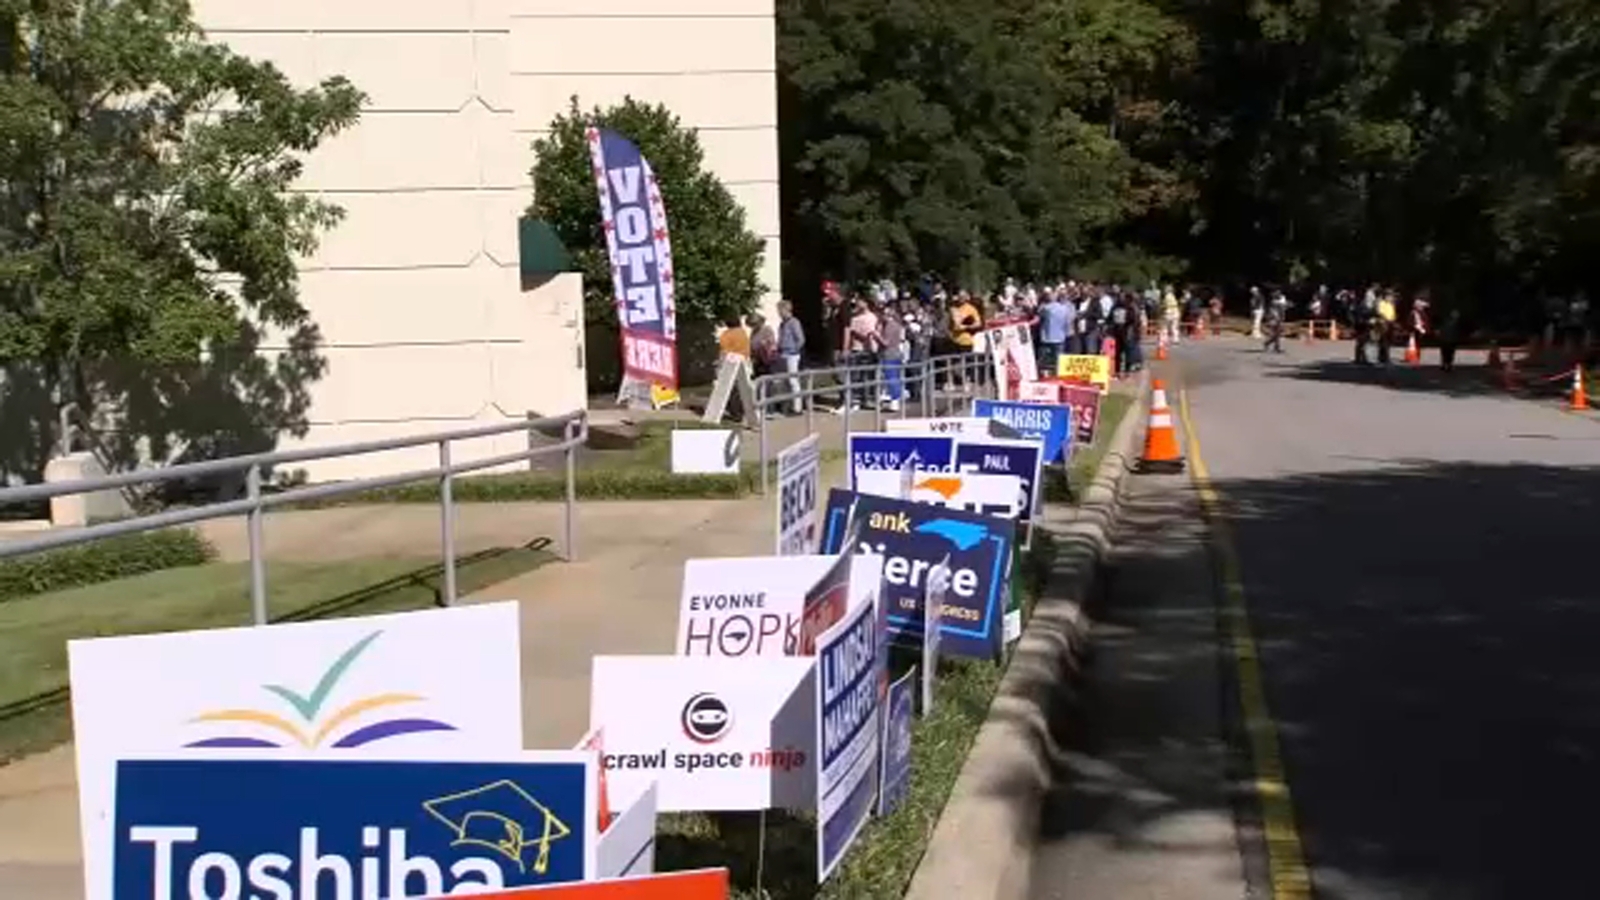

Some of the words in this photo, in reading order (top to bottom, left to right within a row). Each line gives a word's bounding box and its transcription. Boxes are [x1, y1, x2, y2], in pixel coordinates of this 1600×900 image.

[929, 421, 964, 433] VOTE
[992, 405, 1053, 431] HARRIS
[854, 450, 901, 464] KEVIN
[868, 512, 912, 534] ank
[689, 592, 766, 611] EVONNE
[685, 613, 801, 657] HOPK
[603, 749, 667, 769] crawl
[674, 753, 743, 773] space
[749, 746, 806, 772] ninja
[129, 827, 503, 900] Toshiba
